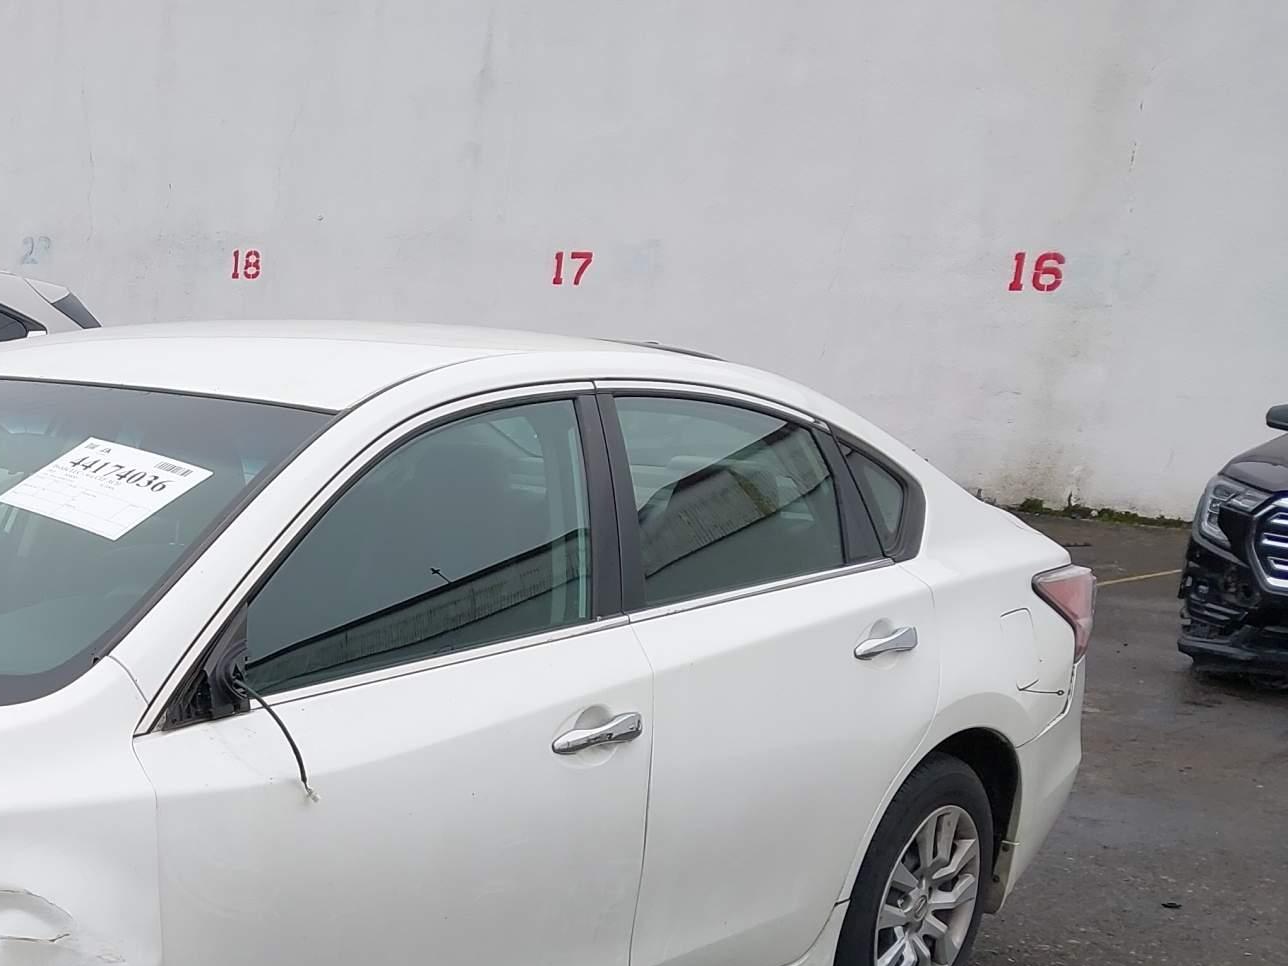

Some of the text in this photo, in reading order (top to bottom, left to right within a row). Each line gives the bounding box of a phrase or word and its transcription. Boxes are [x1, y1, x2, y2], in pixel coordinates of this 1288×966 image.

[231, 249, 261, 280] 18
[552, 251, 593, 286] 17
[1008, 252, 1066, 292] 16
[69, 456, 176, 492] 44174036
